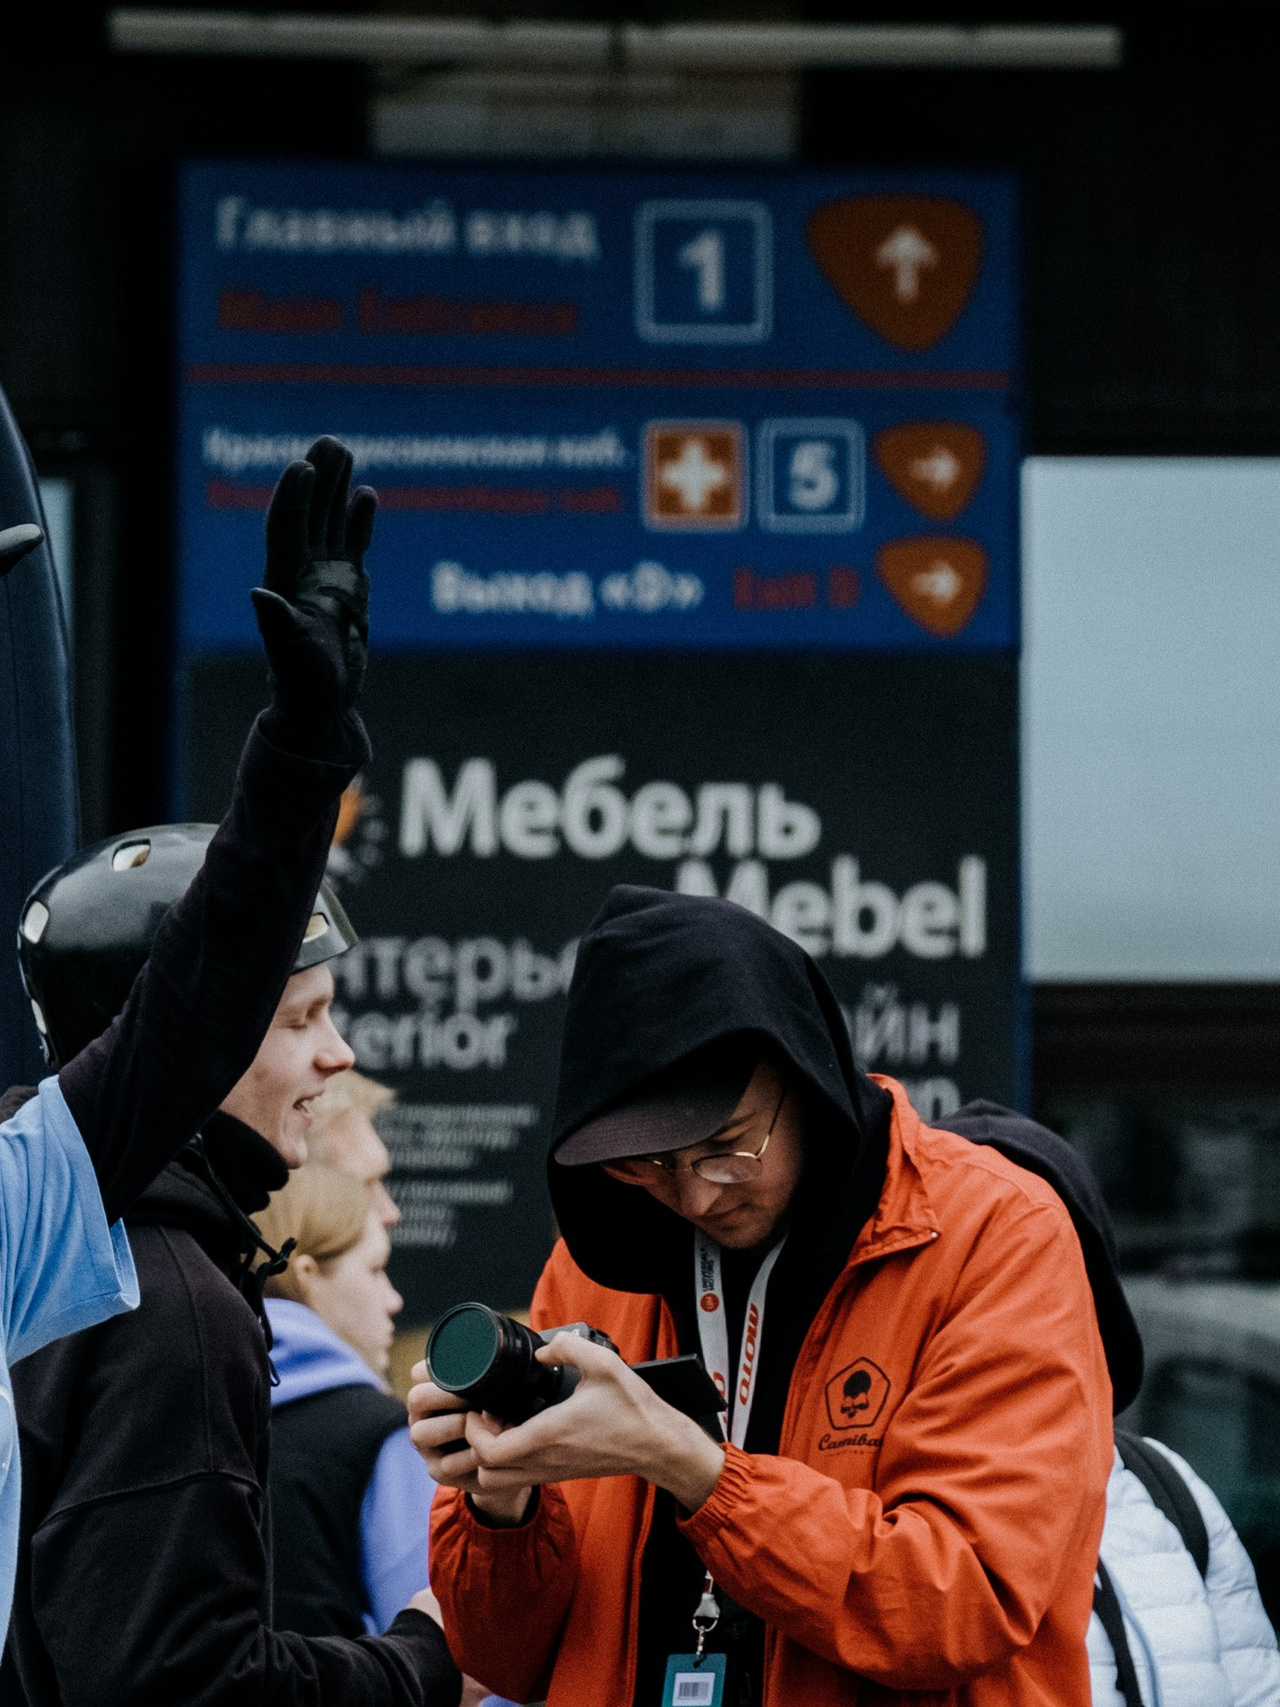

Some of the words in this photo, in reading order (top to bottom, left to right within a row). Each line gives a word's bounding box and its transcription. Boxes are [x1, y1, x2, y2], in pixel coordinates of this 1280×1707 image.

[679, 230, 724, 313] 1
[789, 442, 839, 510] 5
[400, 753, 821, 859] Мебель
